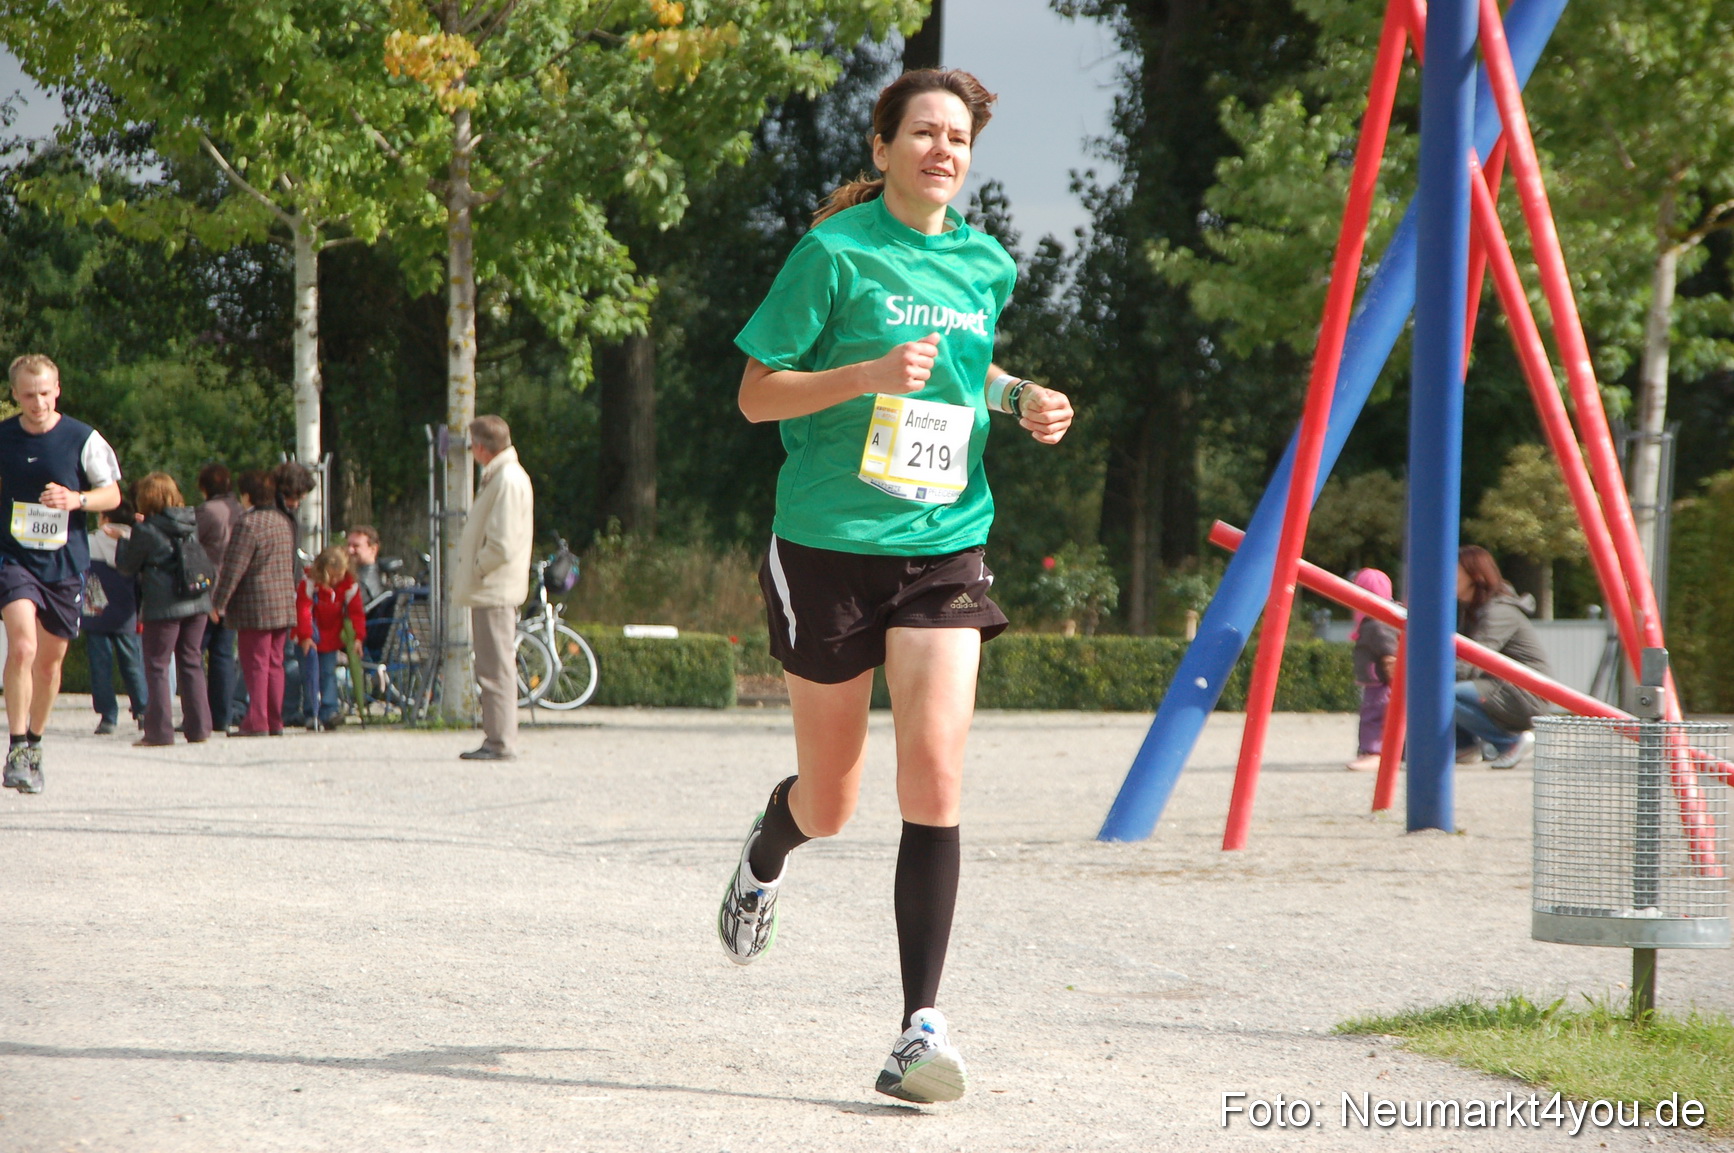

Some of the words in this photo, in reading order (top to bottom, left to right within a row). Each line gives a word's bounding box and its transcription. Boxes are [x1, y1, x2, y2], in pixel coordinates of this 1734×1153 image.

[886, 295, 988, 336] Sinupret
[905, 409, 948, 432] Andrea
[872, 432, 880, 446] A
[907, 441, 951, 471] 219
[32, 521, 58, 535] 880
